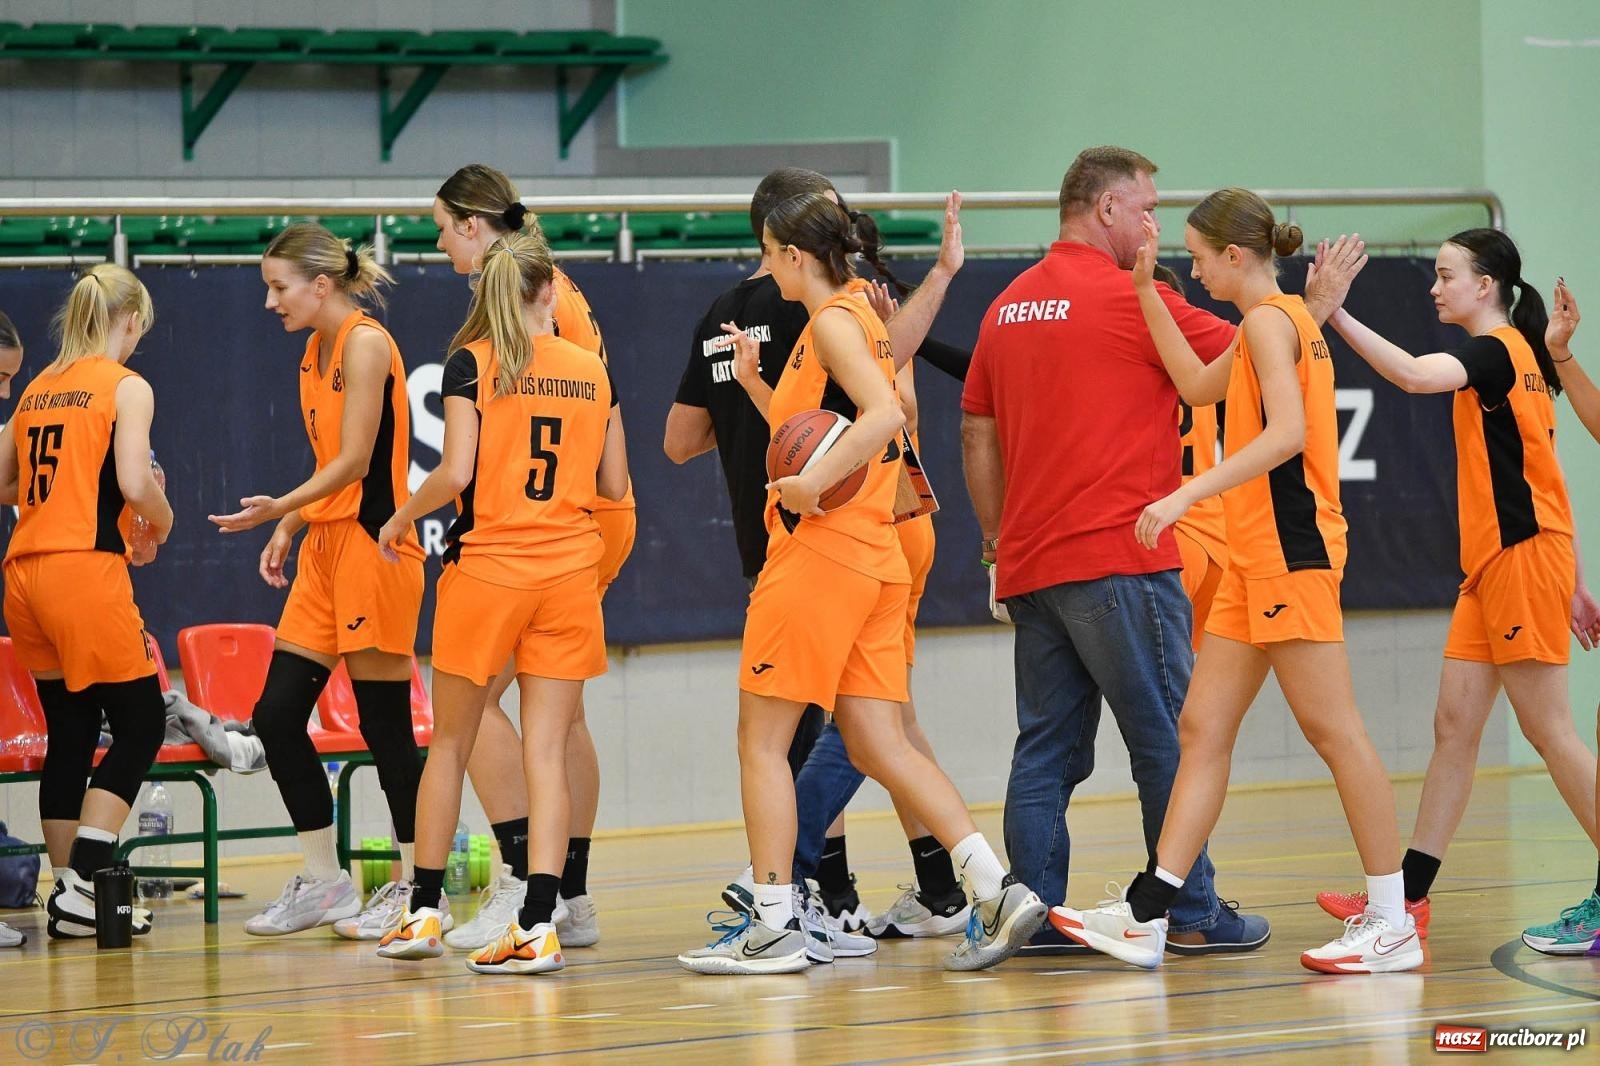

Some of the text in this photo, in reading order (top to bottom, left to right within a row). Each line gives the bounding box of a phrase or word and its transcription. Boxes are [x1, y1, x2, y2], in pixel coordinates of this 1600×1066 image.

[997, 299, 1071, 326] TRENER
[34, 390, 50, 411] UŚ
[47, 390, 94, 409] KATOWICE
[520, 372, 535, 395] UŚ
[538, 377, 596, 402] KATOWICE
[524, 415, 562, 501] 5
[783, 426, 814, 466] molten
[27, 423, 65, 506] 15
[116, 905, 131, 915] KFD
